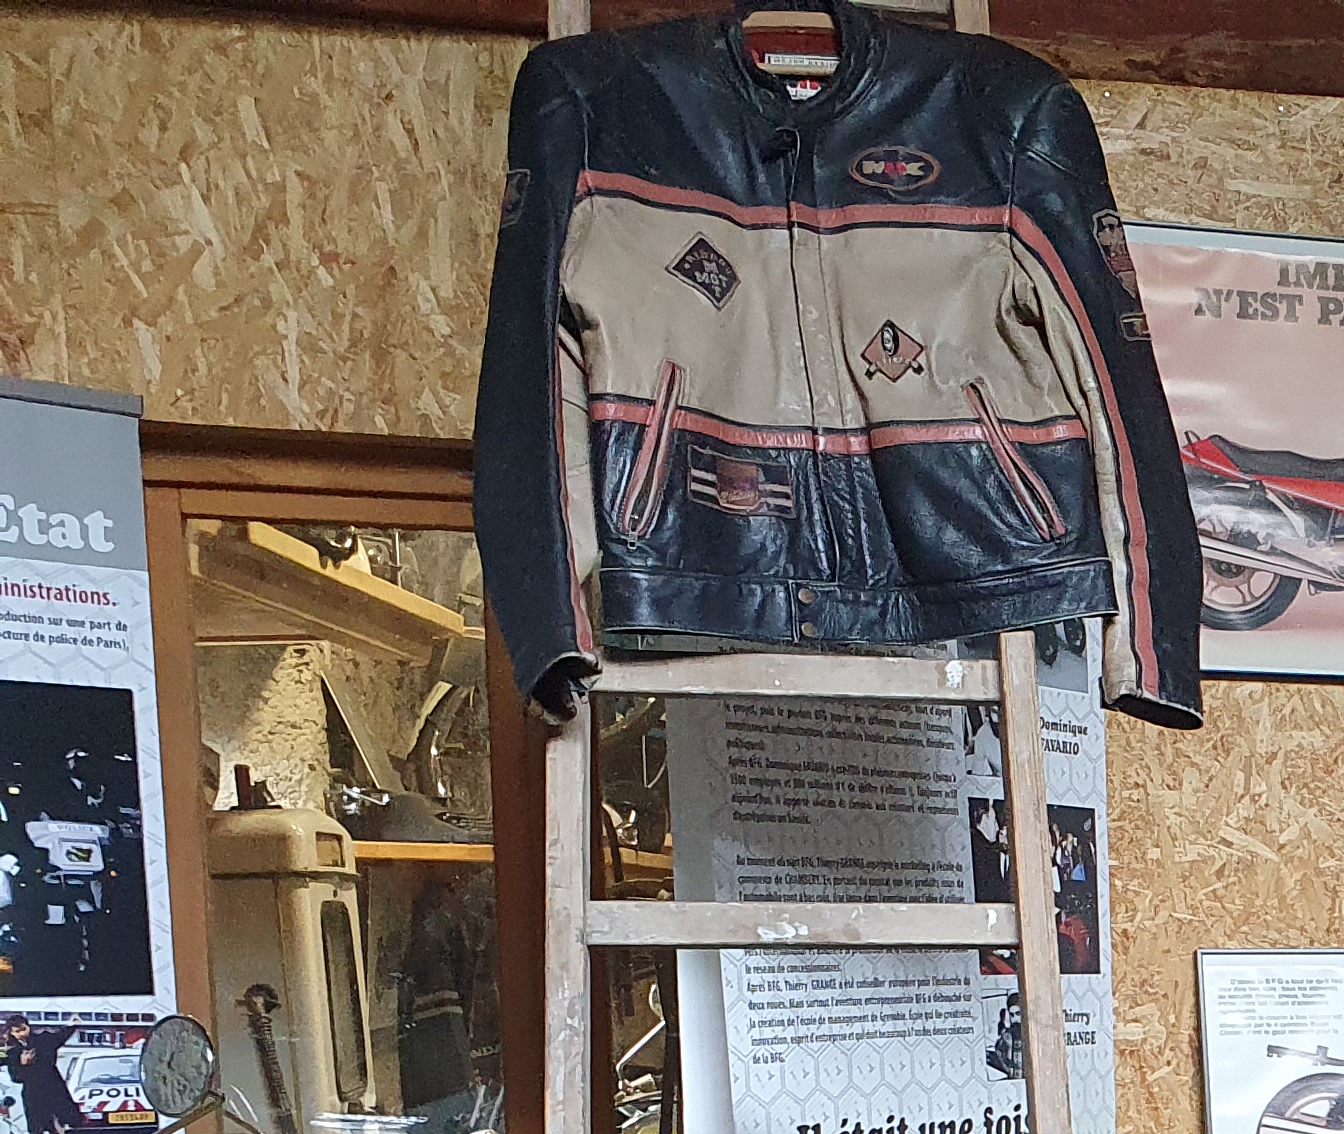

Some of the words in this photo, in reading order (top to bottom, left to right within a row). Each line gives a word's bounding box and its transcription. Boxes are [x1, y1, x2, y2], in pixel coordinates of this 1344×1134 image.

[1194, 287, 1303, 323] N'EST
[0, 577, 118, 607] inistrations.
[116, 621, 128, 632] de
[1062, 1009, 1090, 1025] hierry
[1063, 1031, 1096, 1045] RANGE
[88, 1087, 140, 1099] POLI
